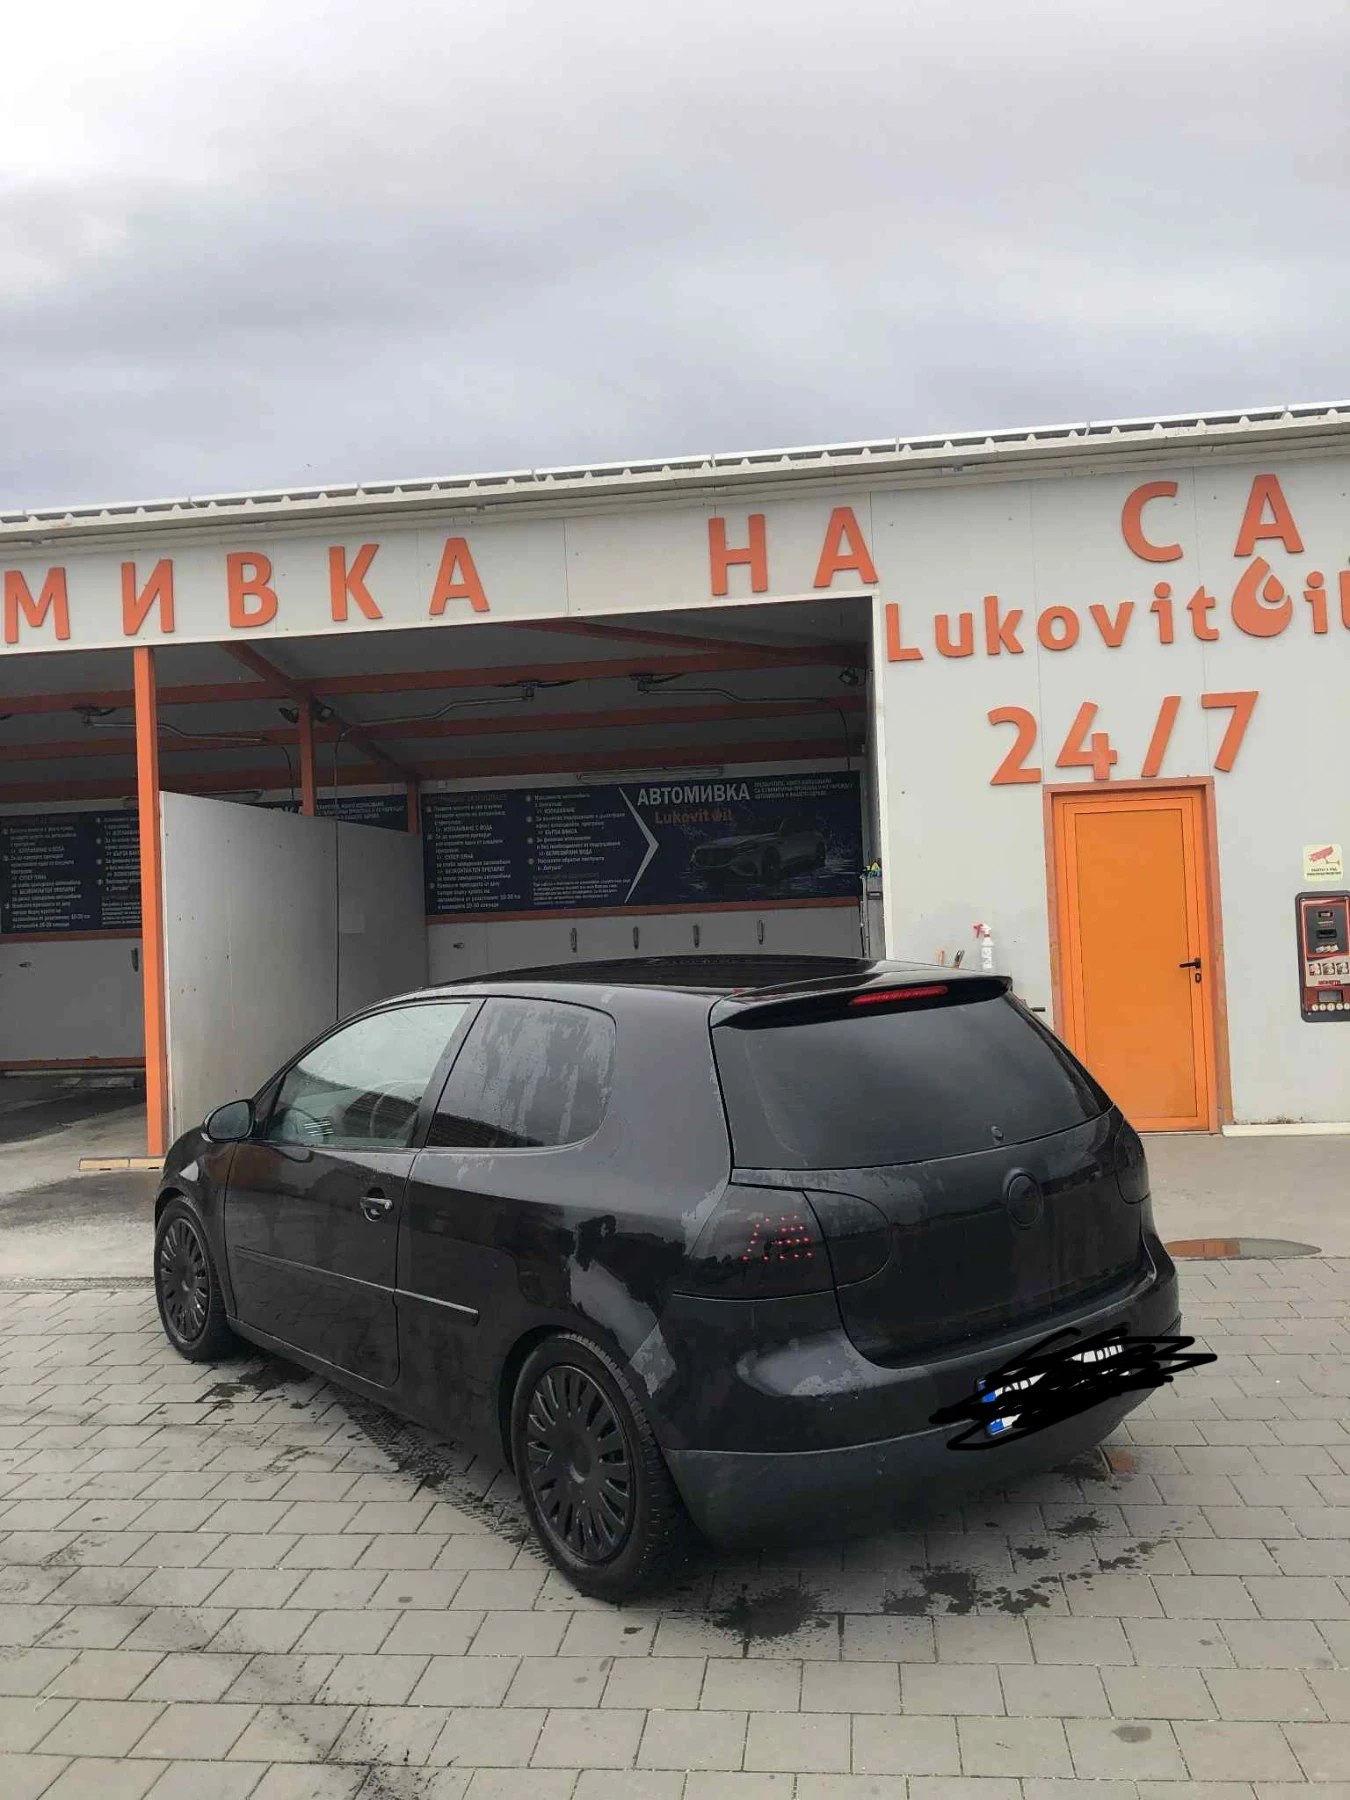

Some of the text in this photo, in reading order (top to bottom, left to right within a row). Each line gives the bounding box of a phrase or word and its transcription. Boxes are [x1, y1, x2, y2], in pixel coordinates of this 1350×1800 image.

[5, 538, 489, 643] МИВКА
[709, 508, 877, 595] НА
[988, 691, 1258, 785] 24/7
[637, 783, 751, 806] АВТОМИВКА
